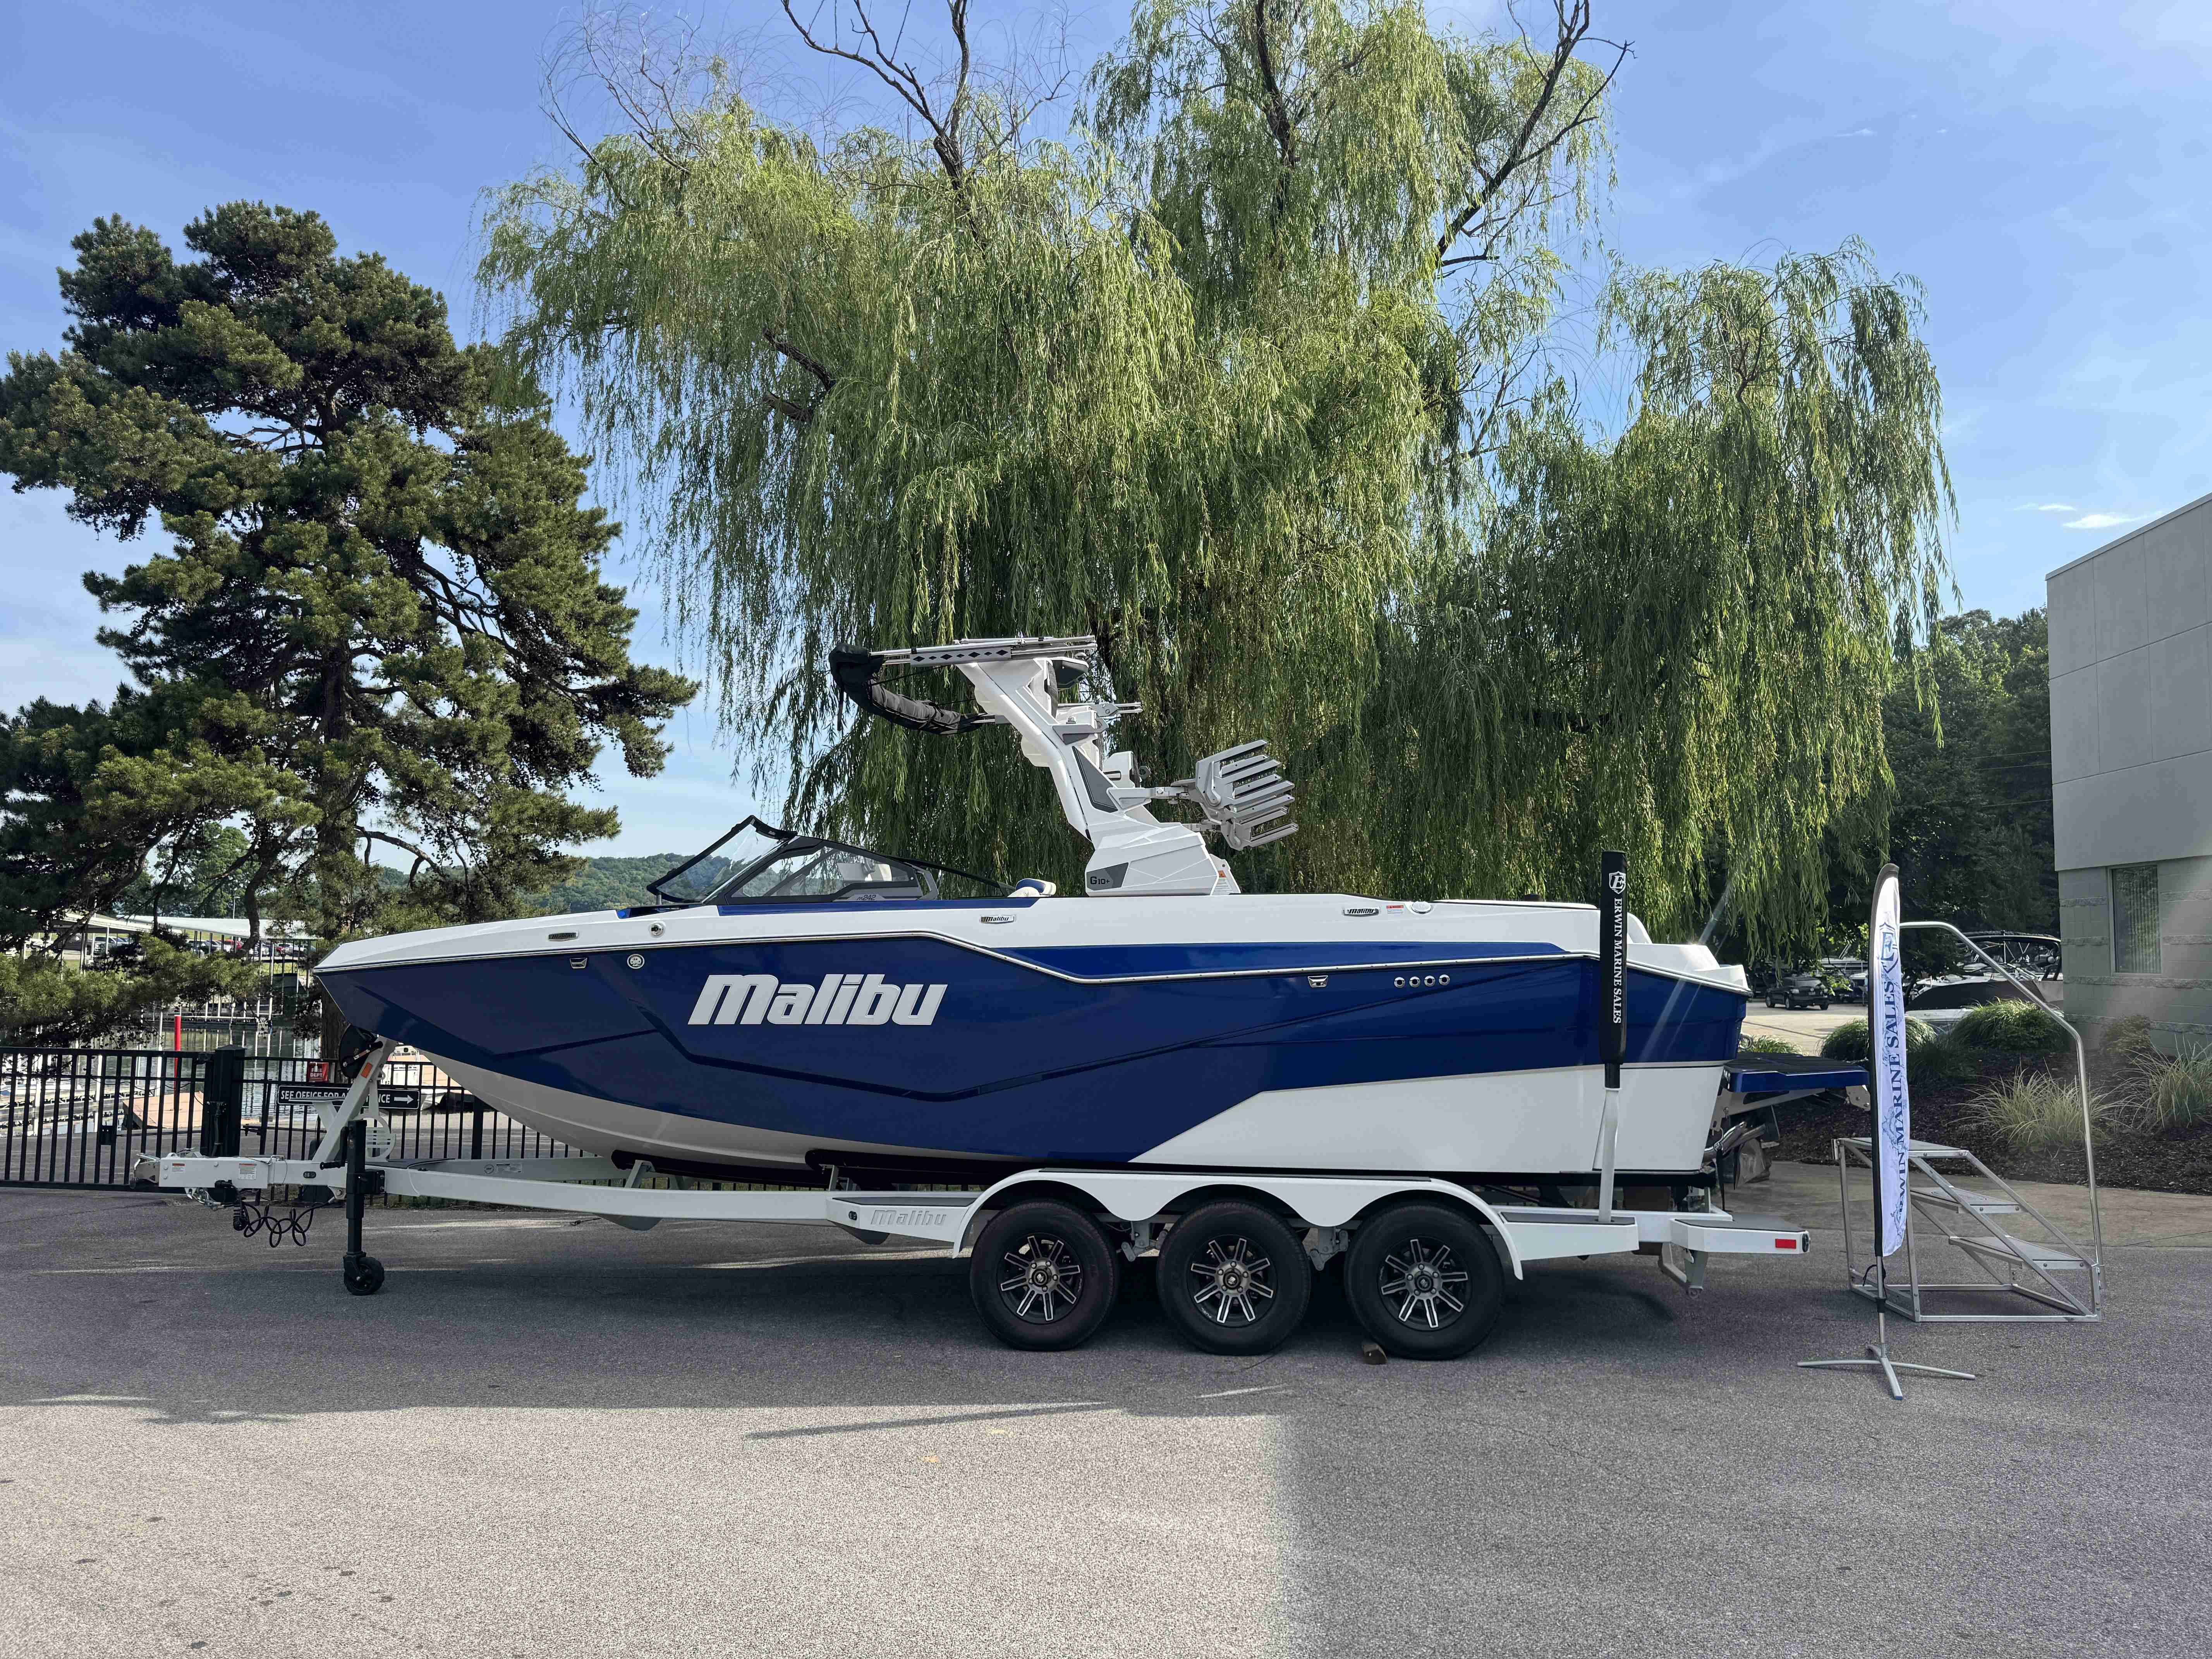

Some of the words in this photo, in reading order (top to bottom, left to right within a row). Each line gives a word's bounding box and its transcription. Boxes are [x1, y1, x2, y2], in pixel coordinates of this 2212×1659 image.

[1090, 876, 1110, 884] G10+
[1614, 898, 1622, 938] ERWIN
[1614, 939, 1622, 986] MARINE
[688, 974, 948, 1025] Malibu
[1613, 988, 1622, 1024] SALES
[1884, 981, 1899, 1048] SALES
[281, 1091, 294, 1099] SEE
[1889, 1053, 1904, 1145] MARINE
[1897, 1152, 1905, 1220] WIN
[871, 1209, 946, 1226] Malibu
